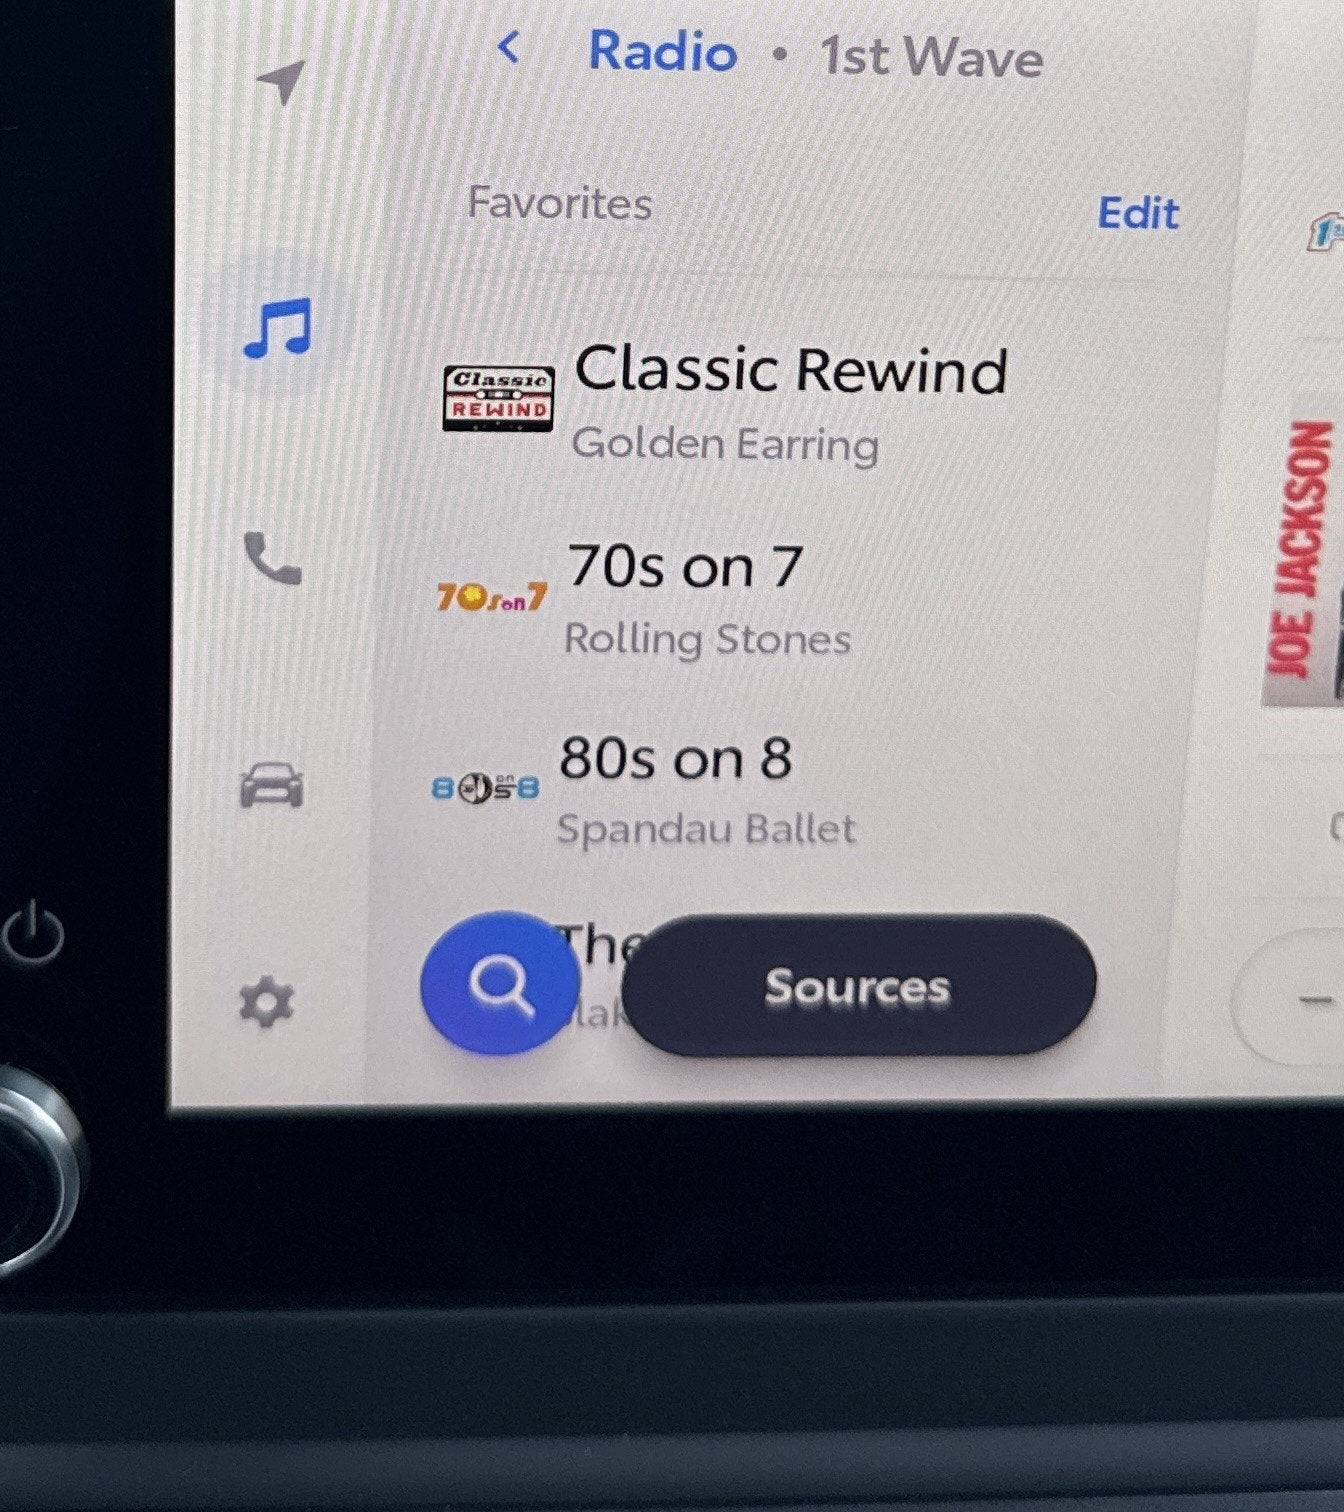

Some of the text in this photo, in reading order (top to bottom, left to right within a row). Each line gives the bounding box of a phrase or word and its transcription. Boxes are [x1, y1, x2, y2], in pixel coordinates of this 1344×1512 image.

[591, 29, 737, 71] Radio
[822, 34, 1043, 78] 1st Wave
[470, 185, 651, 220] Favorites
[1099, 196, 1179, 229] Edit
[454, 371, 547, 386] Classic
[577, 343, 1007, 394] Classic Rewind
[452, 402, 547, 416] REWIND
[573, 425, 878, 470] Golden Earring
[569, 543, 803, 588] 70s on 7
[1266, 420, 1335, 680] JOE JACKSON
[566, 621, 850, 663] Rolling Stones
[561, 736, 791, 779] 80s on 8
[558, 812, 855, 849] Spandau Ballet
[766, 968, 949, 1005] Sources
